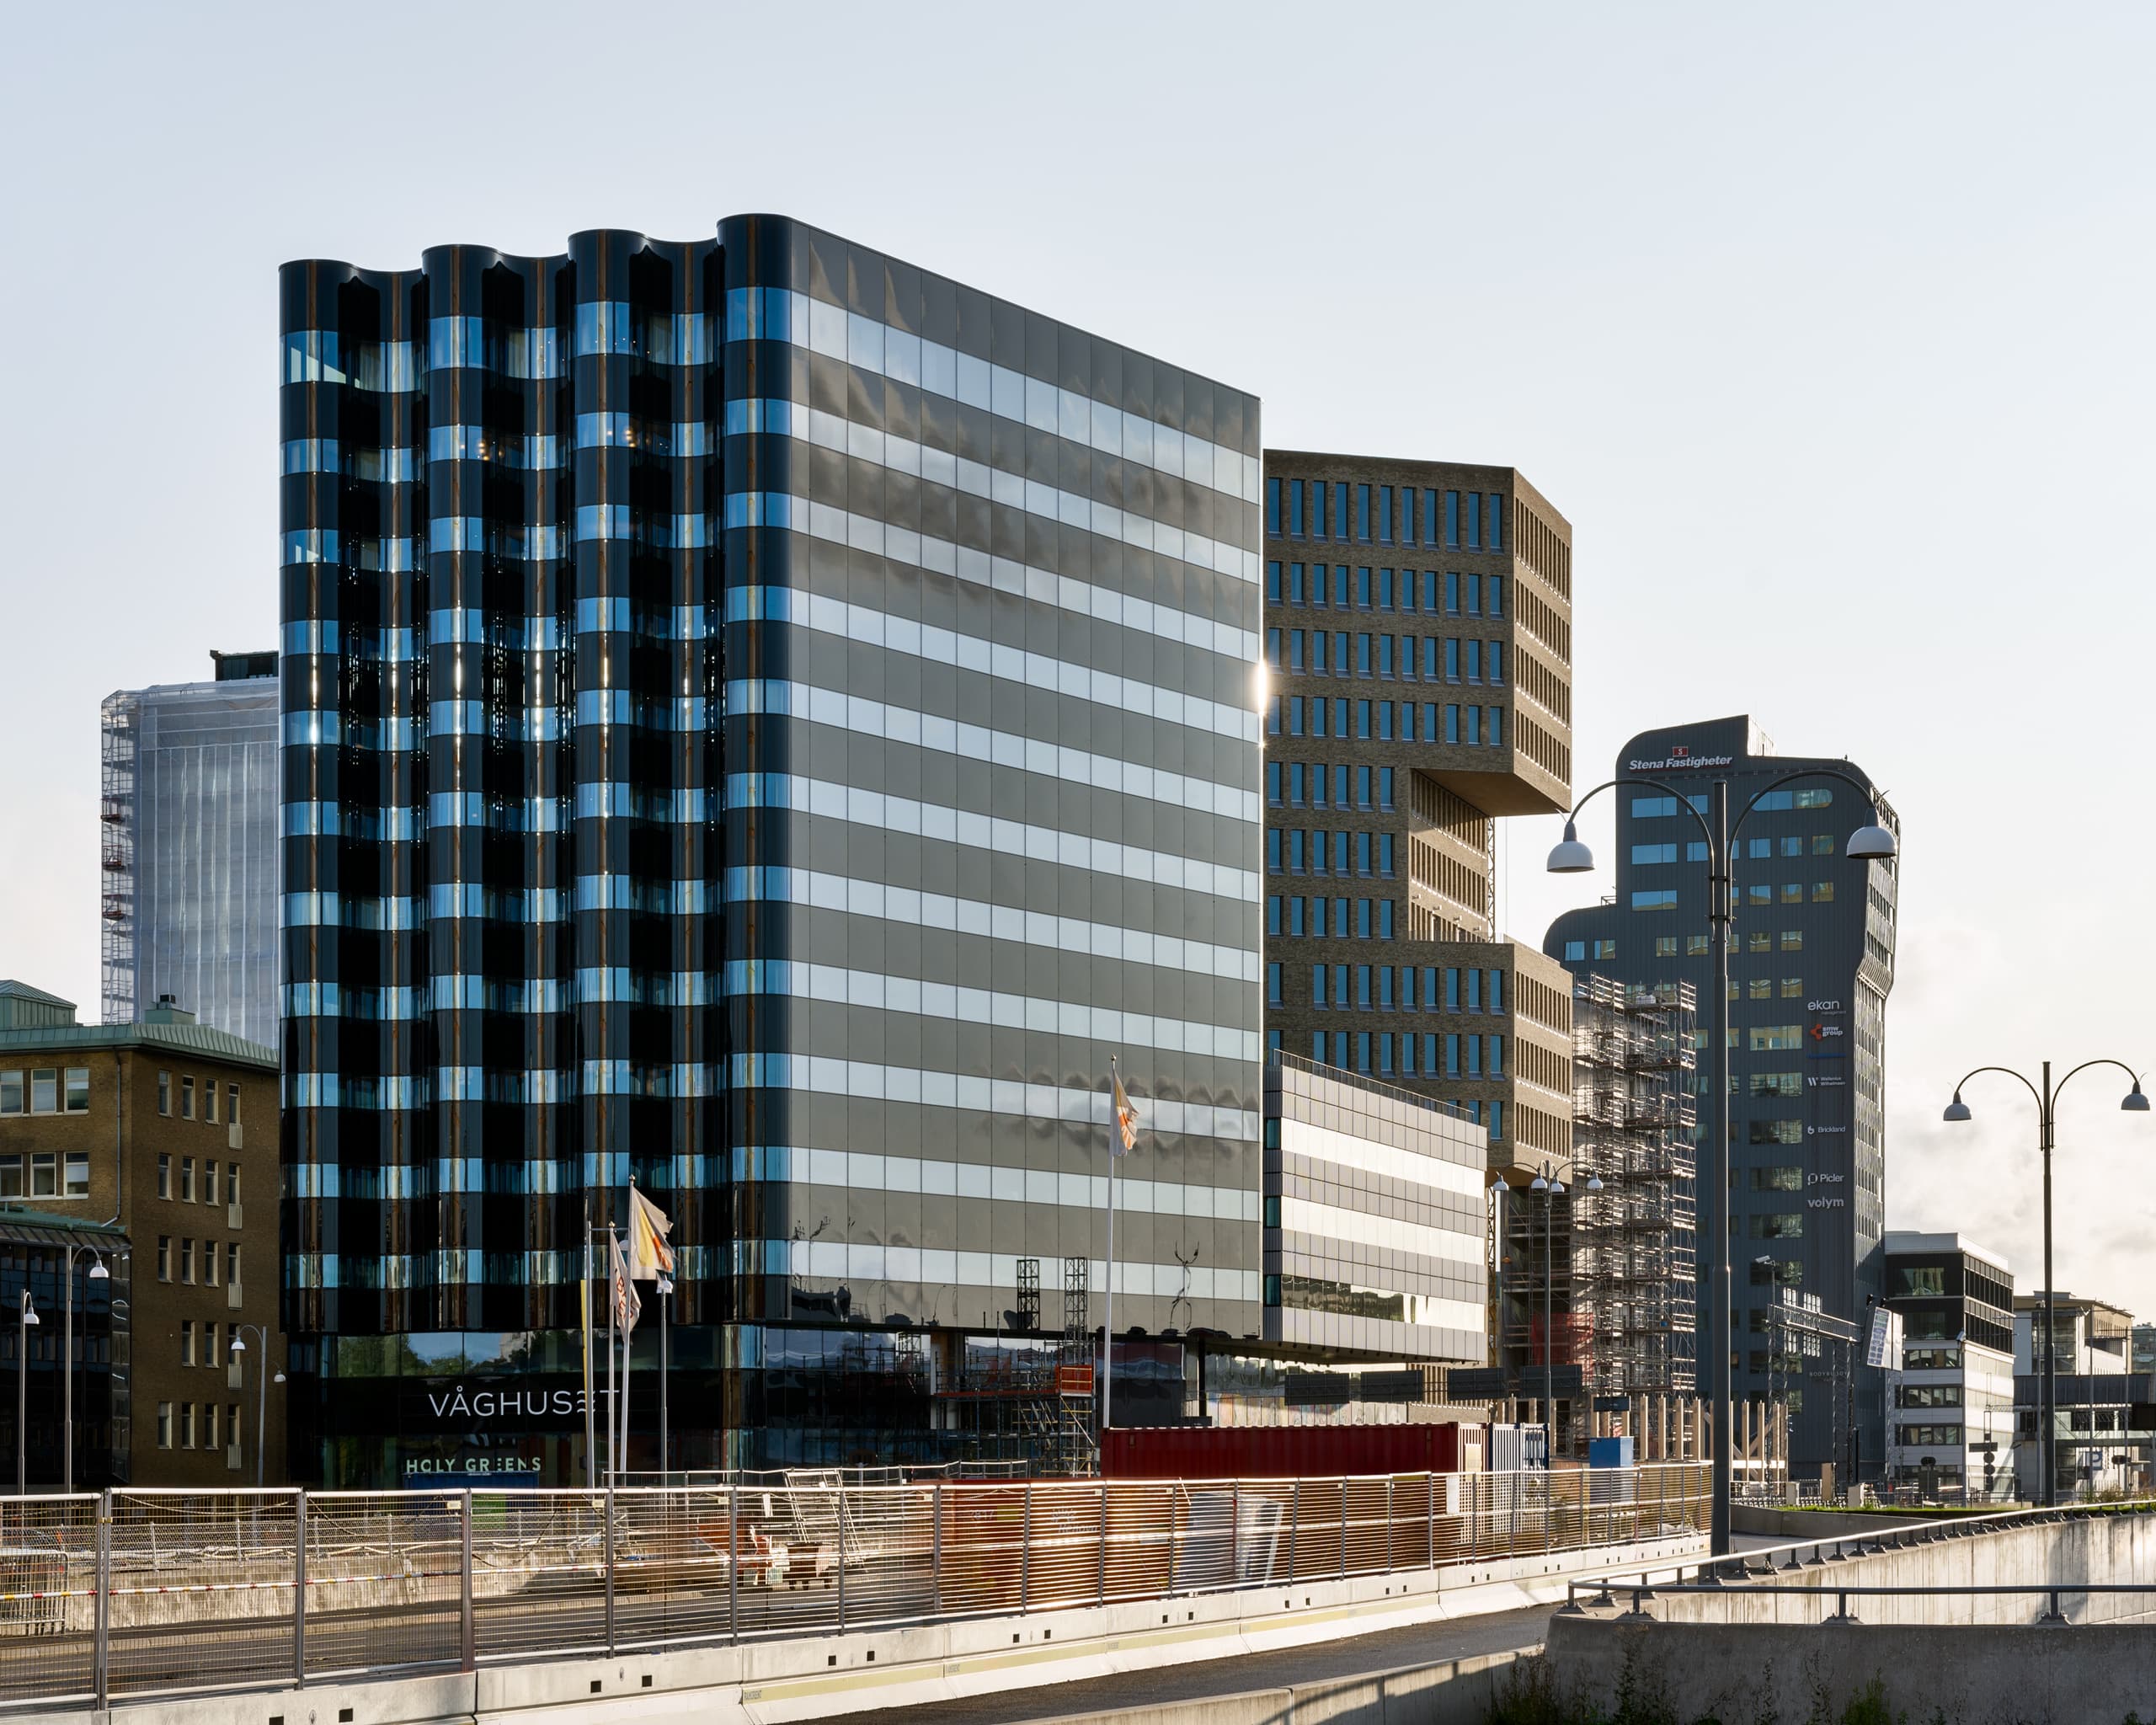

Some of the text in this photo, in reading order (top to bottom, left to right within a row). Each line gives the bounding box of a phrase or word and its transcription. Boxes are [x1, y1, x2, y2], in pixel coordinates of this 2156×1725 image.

[1629, 756, 1732, 770] Stena Fastigheter
[1807, 1000, 1840, 1011] ekan
[1820, 1173, 1845, 1183] Picler
[1807, 1196, 1844, 1210] volym
[406, 1456, 542, 1473] HOLY GREENS
